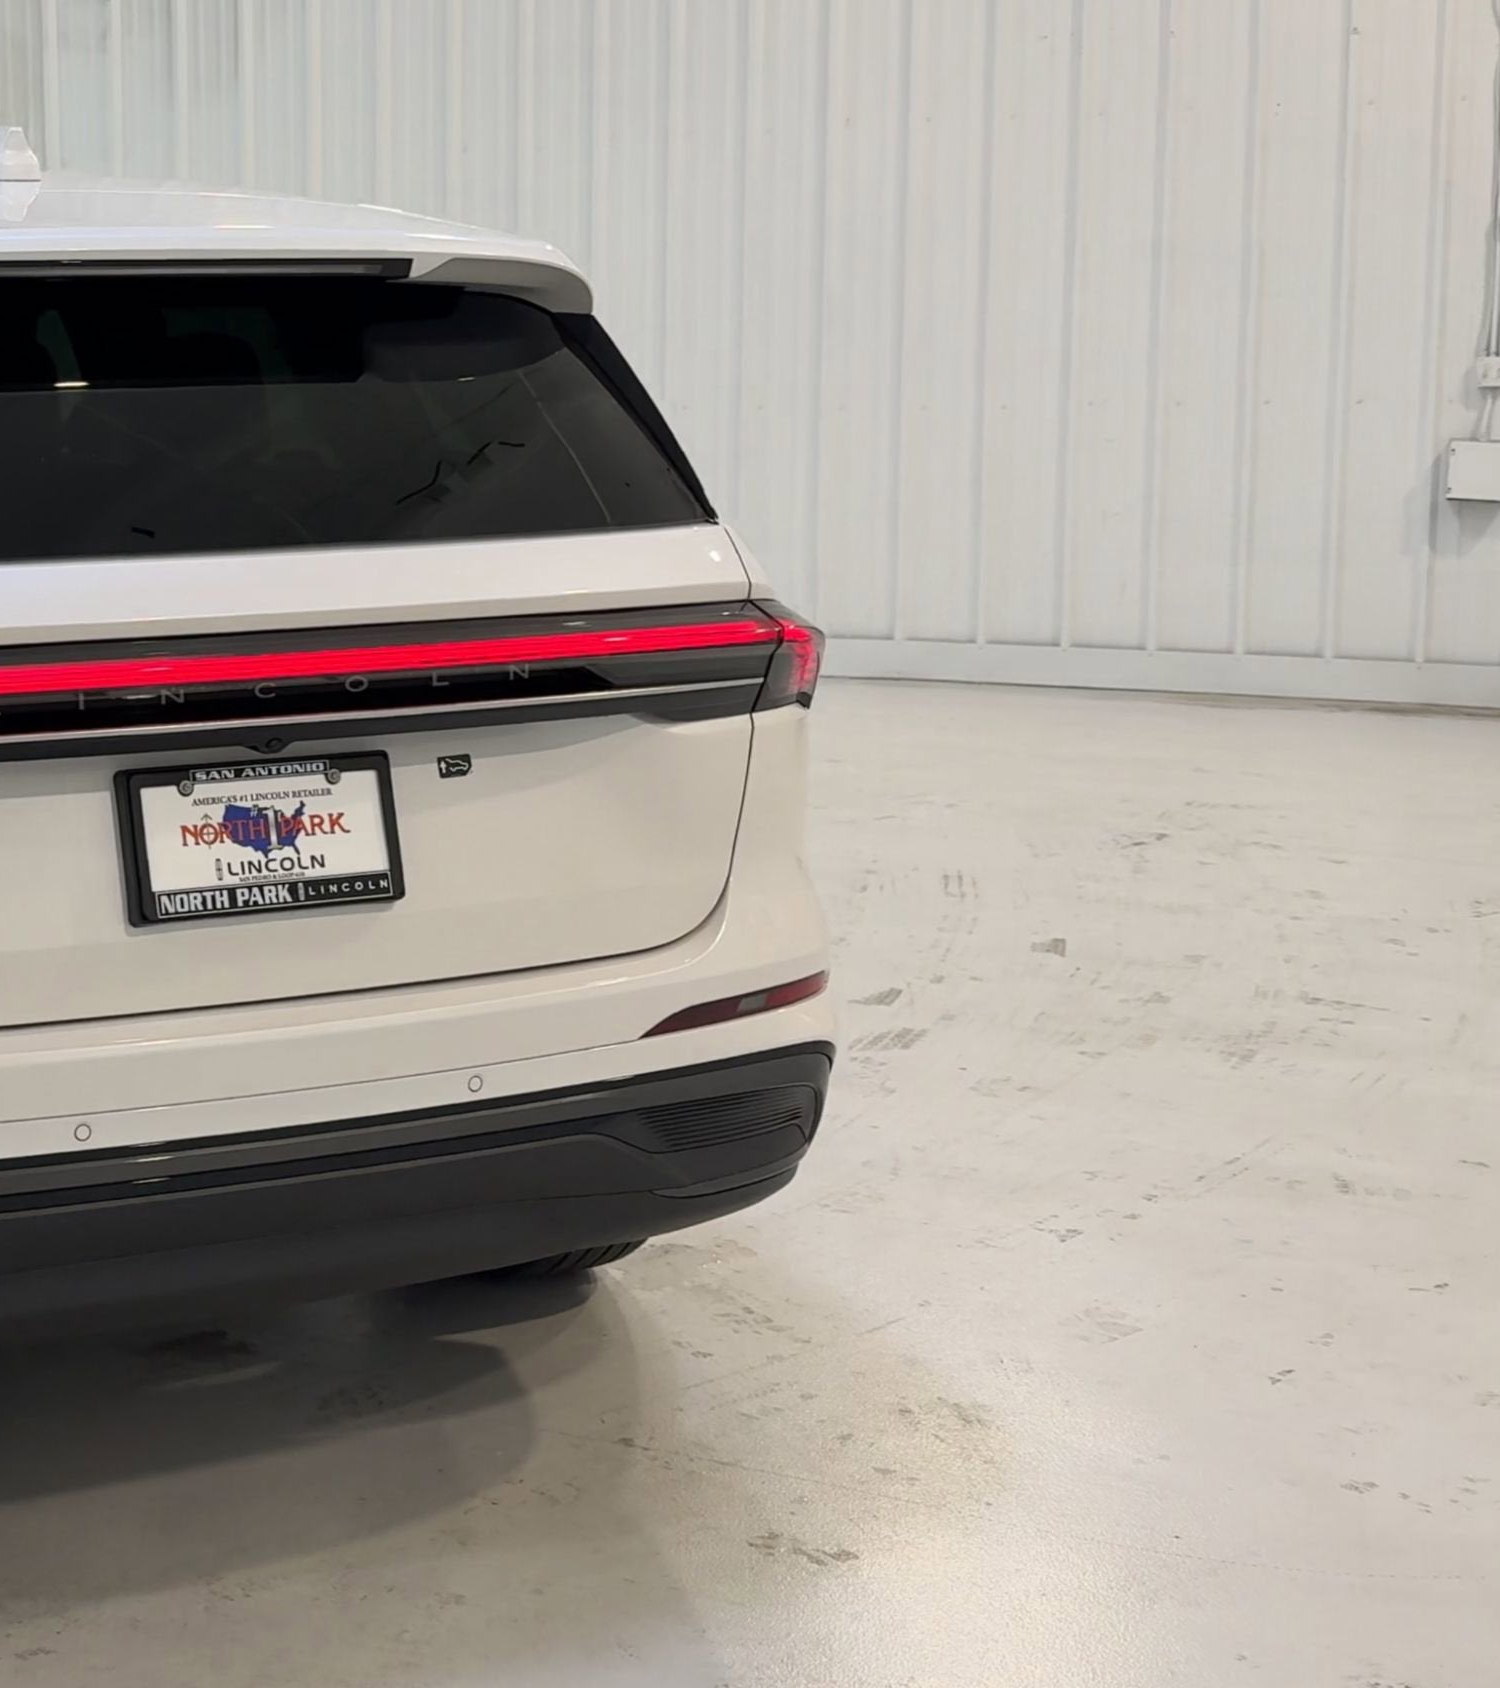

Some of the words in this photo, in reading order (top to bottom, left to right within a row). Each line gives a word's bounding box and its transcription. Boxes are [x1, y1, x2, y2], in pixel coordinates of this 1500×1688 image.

[195, 770, 235, 781] SAN
[241, 762, 325, 777] ANTONIO
[191, 795, 238, 807] AMERICA'S
[250, 789, 290, 802] LINCOLN
[292, 787, 333, 799] RETAILER
[180, 816, 267, 847] NORTH
[280, 812, 351, 838] PARK
[227, 854, 326, 876] LINCOLN
[160, 889, 231, 915] NORTH
[236, 883, 293, 907] PARK
[308, 879, 389, 896] LINCOLN
